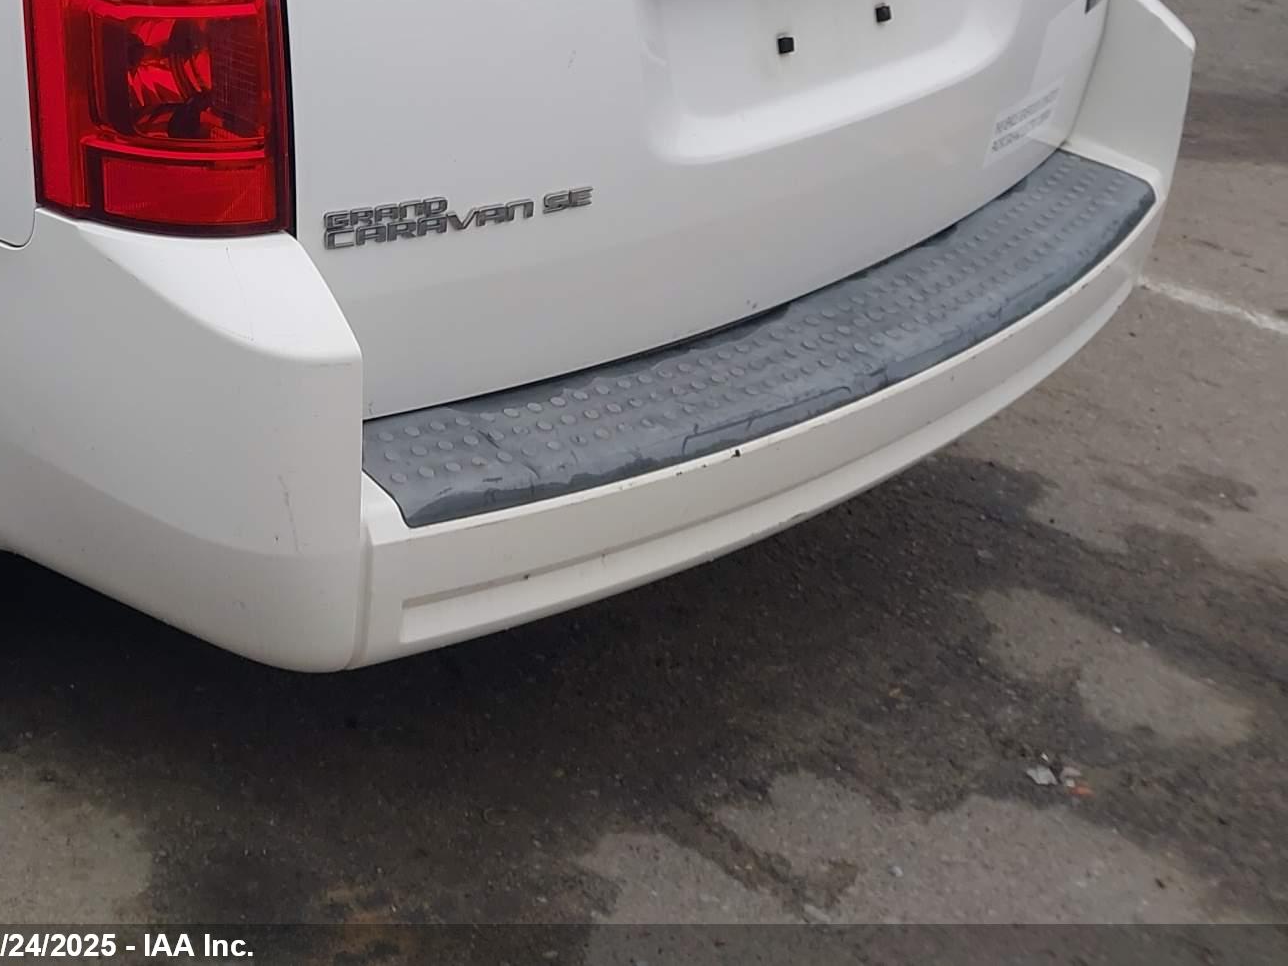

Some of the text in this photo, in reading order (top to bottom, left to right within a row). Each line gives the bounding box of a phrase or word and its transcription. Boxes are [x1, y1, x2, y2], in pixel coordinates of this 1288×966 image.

[323, 196, 448, 231] GRAND
[323, 186, 593, 250] CARAVAN SE
